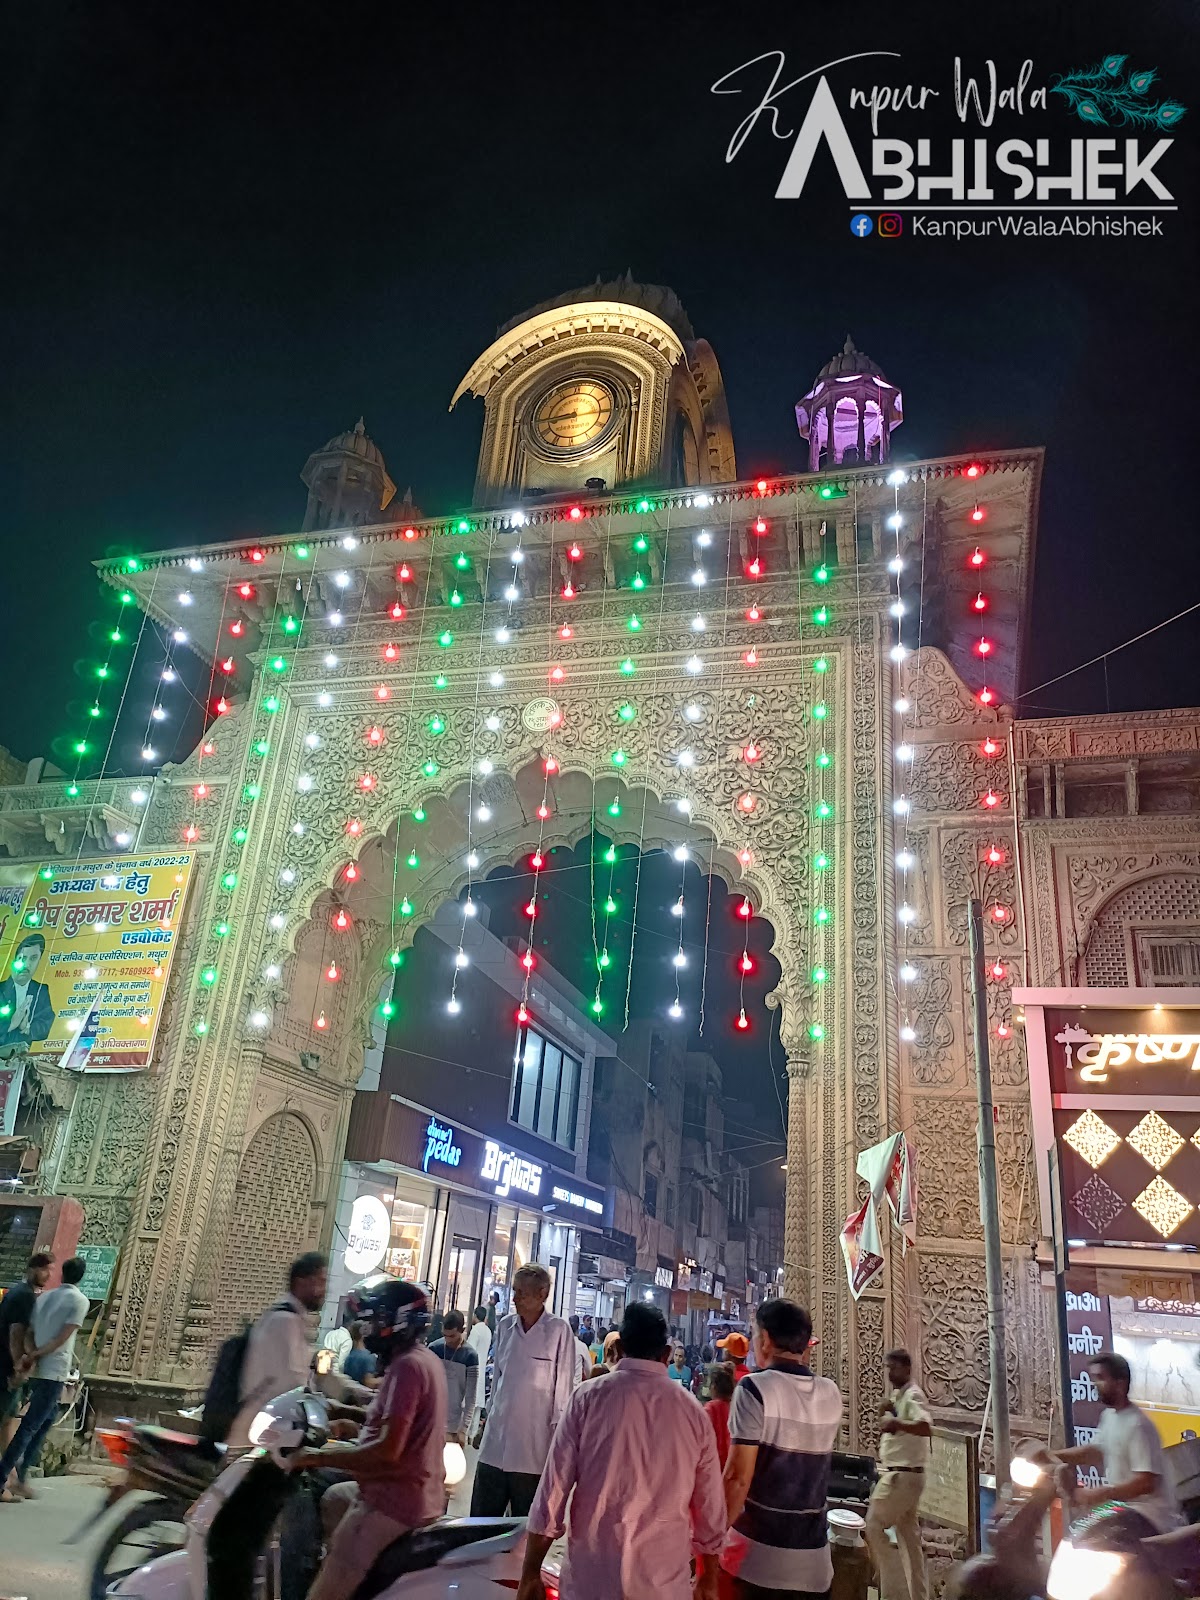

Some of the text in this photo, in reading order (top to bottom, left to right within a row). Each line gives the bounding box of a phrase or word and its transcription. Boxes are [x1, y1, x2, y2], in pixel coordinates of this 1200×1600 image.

[153, 856, 190, 866] 2022-23
[50, 878, 97, 894] अध्यक्ष
[125, 872, 151, 894] हेतु
[64, 902, 127, 936] कुमार
[130, 890, 179, 923] शर्मा
[121, 929, 173, 944] एडवोकेट
[54, 969, 71, 978] Mob.
[423, 1128, 462, 1172] pedas
